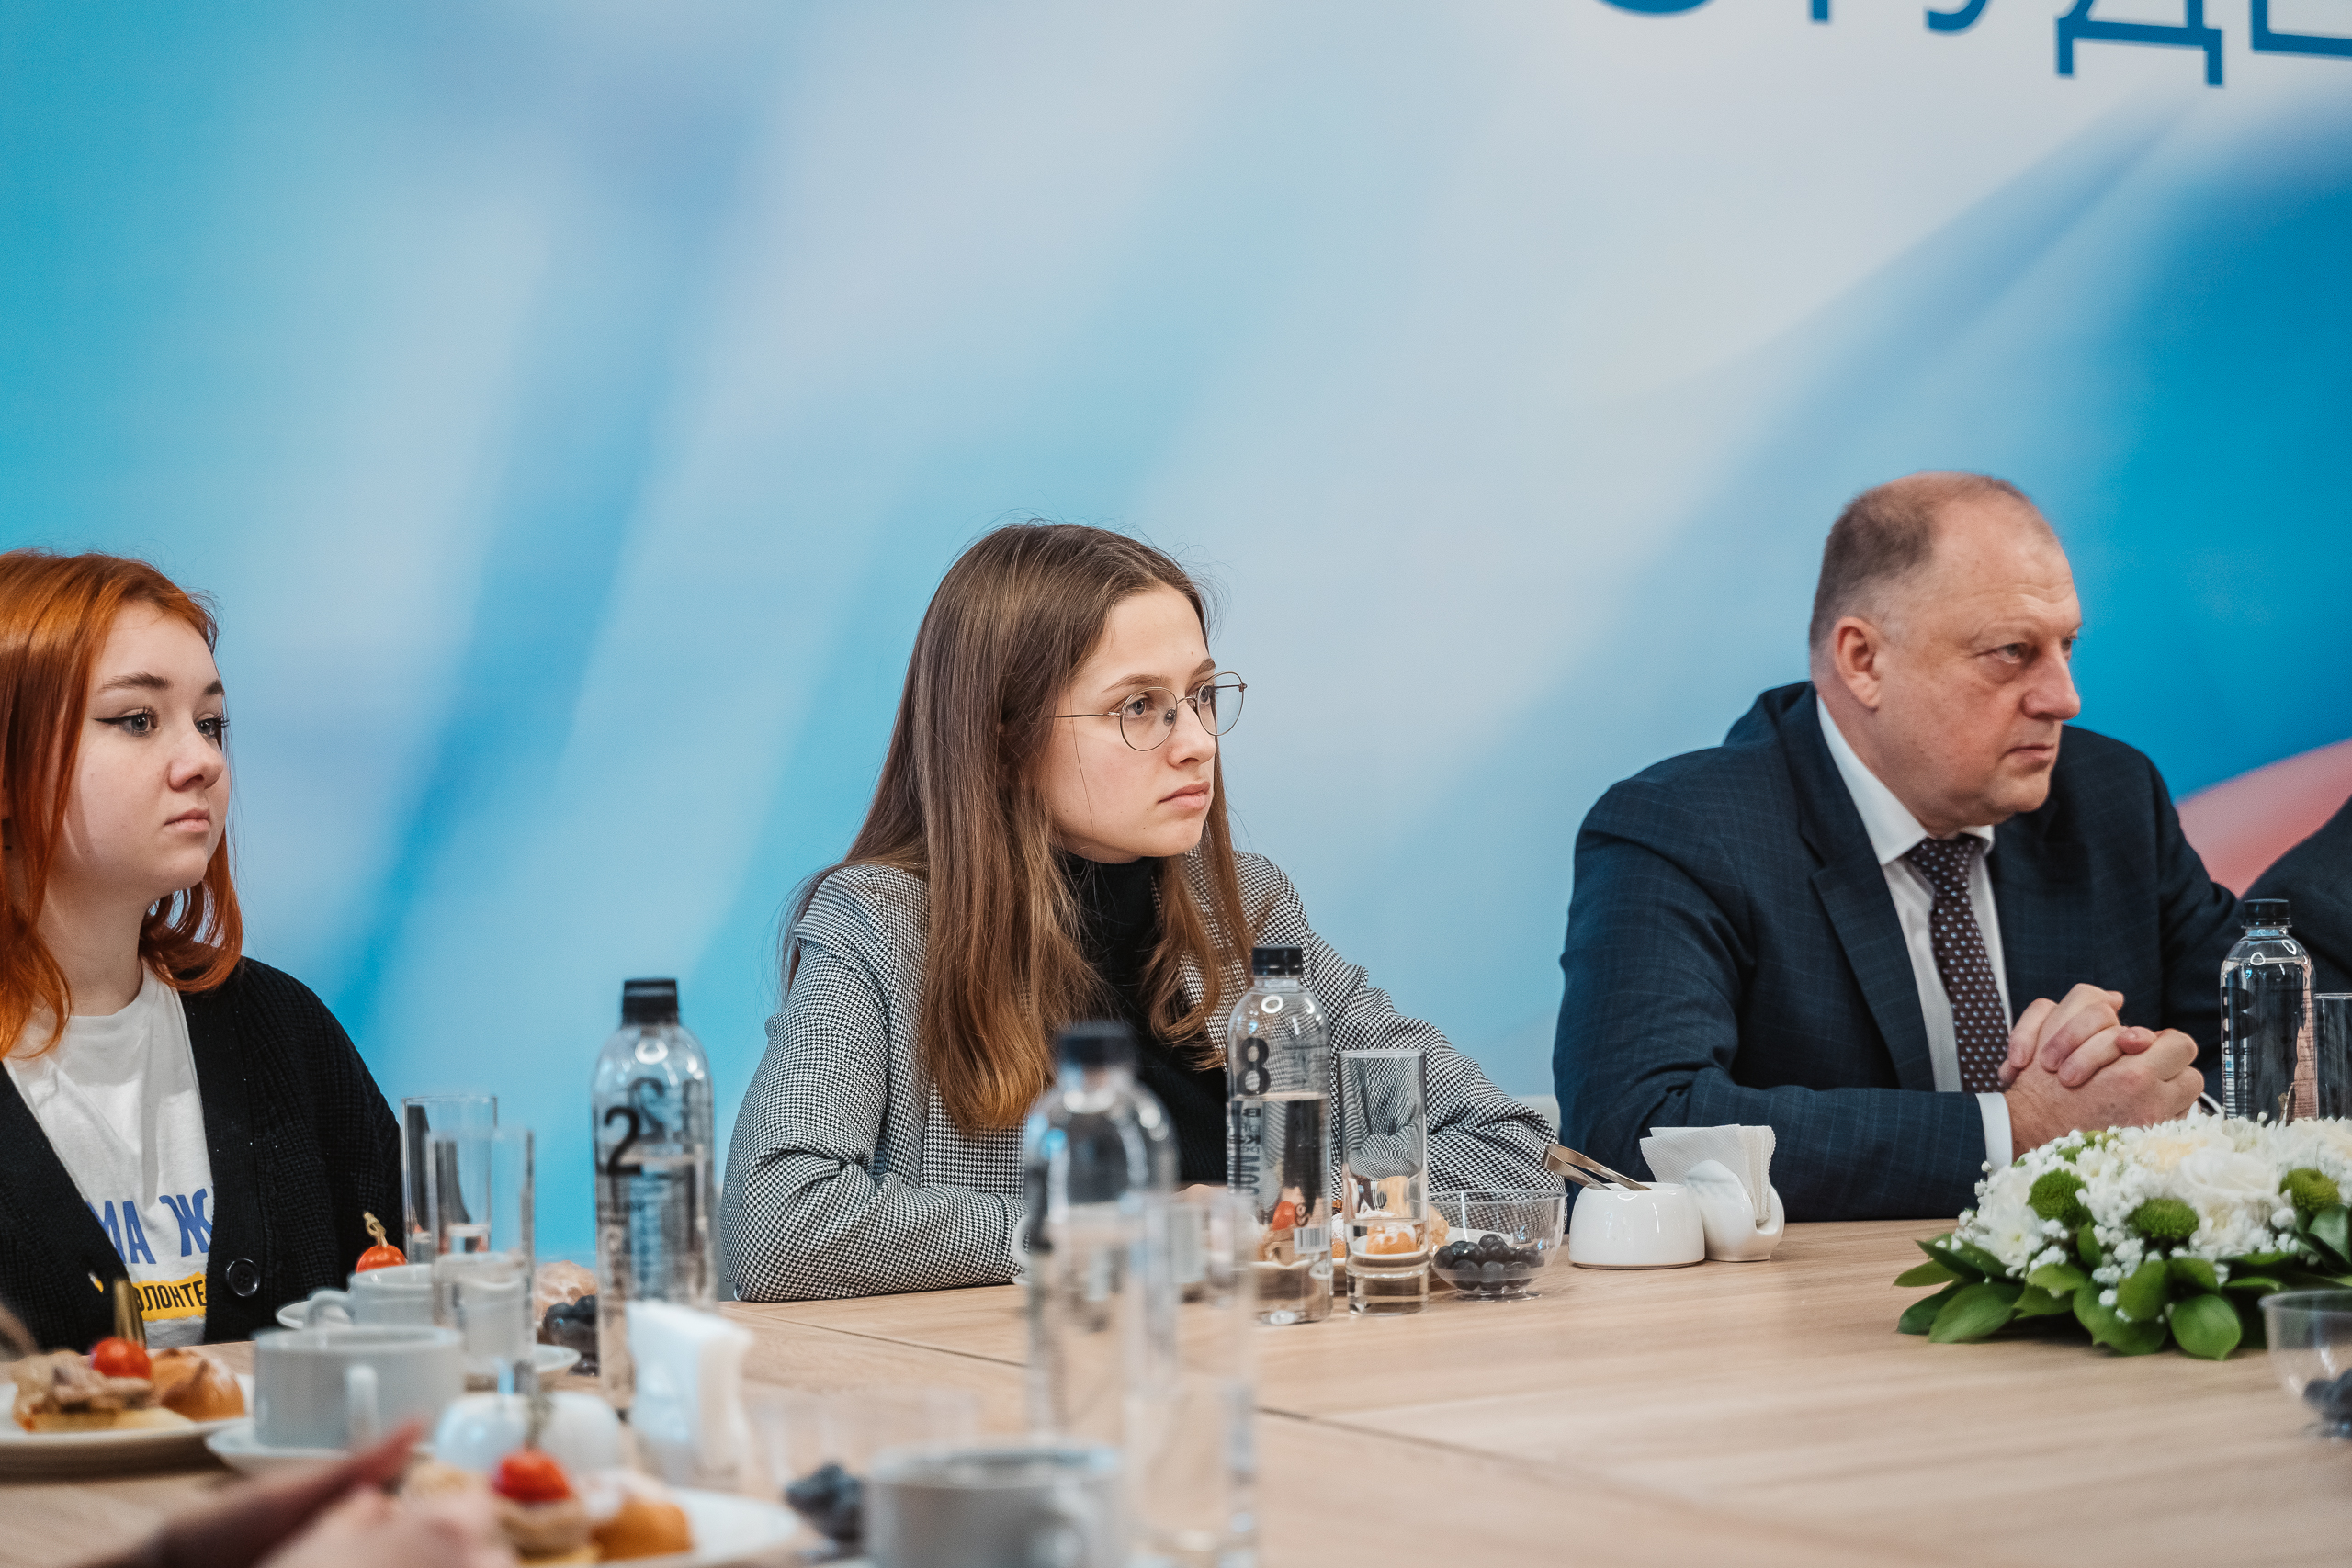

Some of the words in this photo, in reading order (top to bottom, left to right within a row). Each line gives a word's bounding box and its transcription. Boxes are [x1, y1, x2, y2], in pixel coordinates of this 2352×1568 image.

[1236, 1036, 1271, 1096] 8
[604, 1105, 641, 1176] 2
[159, 1187, 213, 1257] Ж
